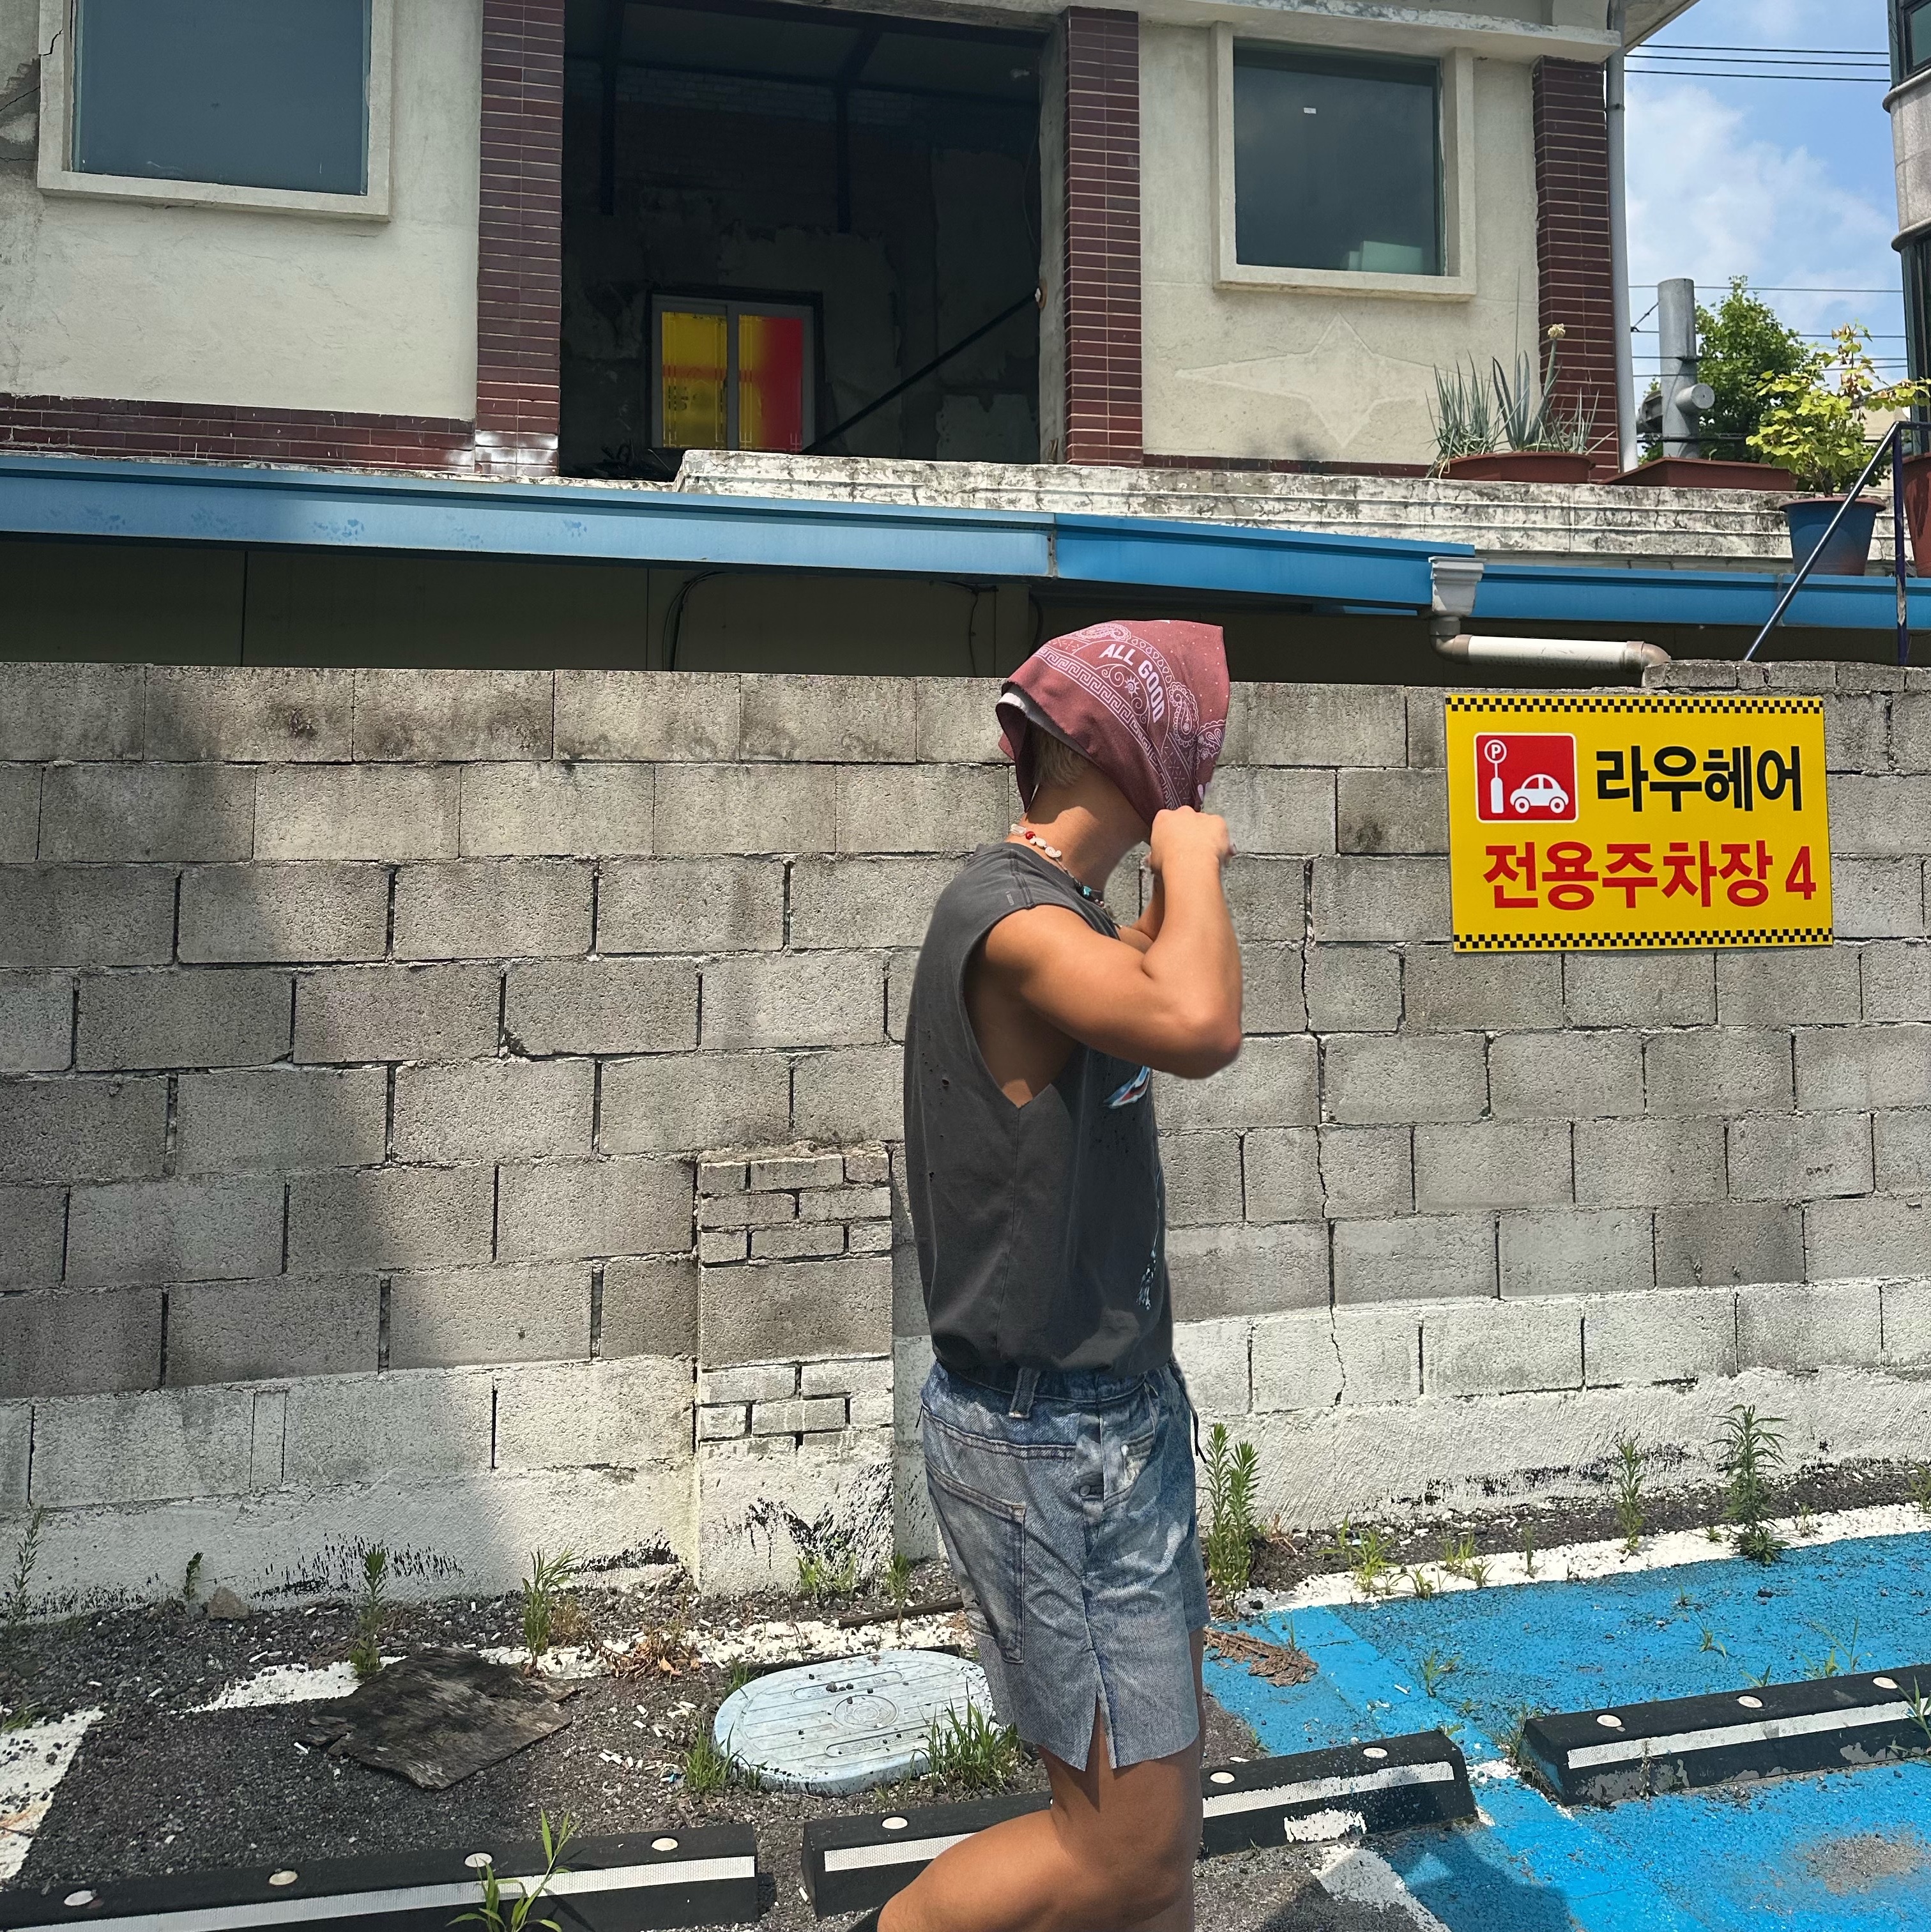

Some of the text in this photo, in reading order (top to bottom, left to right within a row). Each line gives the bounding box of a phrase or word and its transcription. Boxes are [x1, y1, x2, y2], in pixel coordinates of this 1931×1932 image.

[1099, 643, 1165, 723] ALL GOOD
[1492, 744, 1501, 759] P
[1596, 745, 1803, 812] 라우헤어
[1483, 839, 1817, 910] 전용주차장 4
